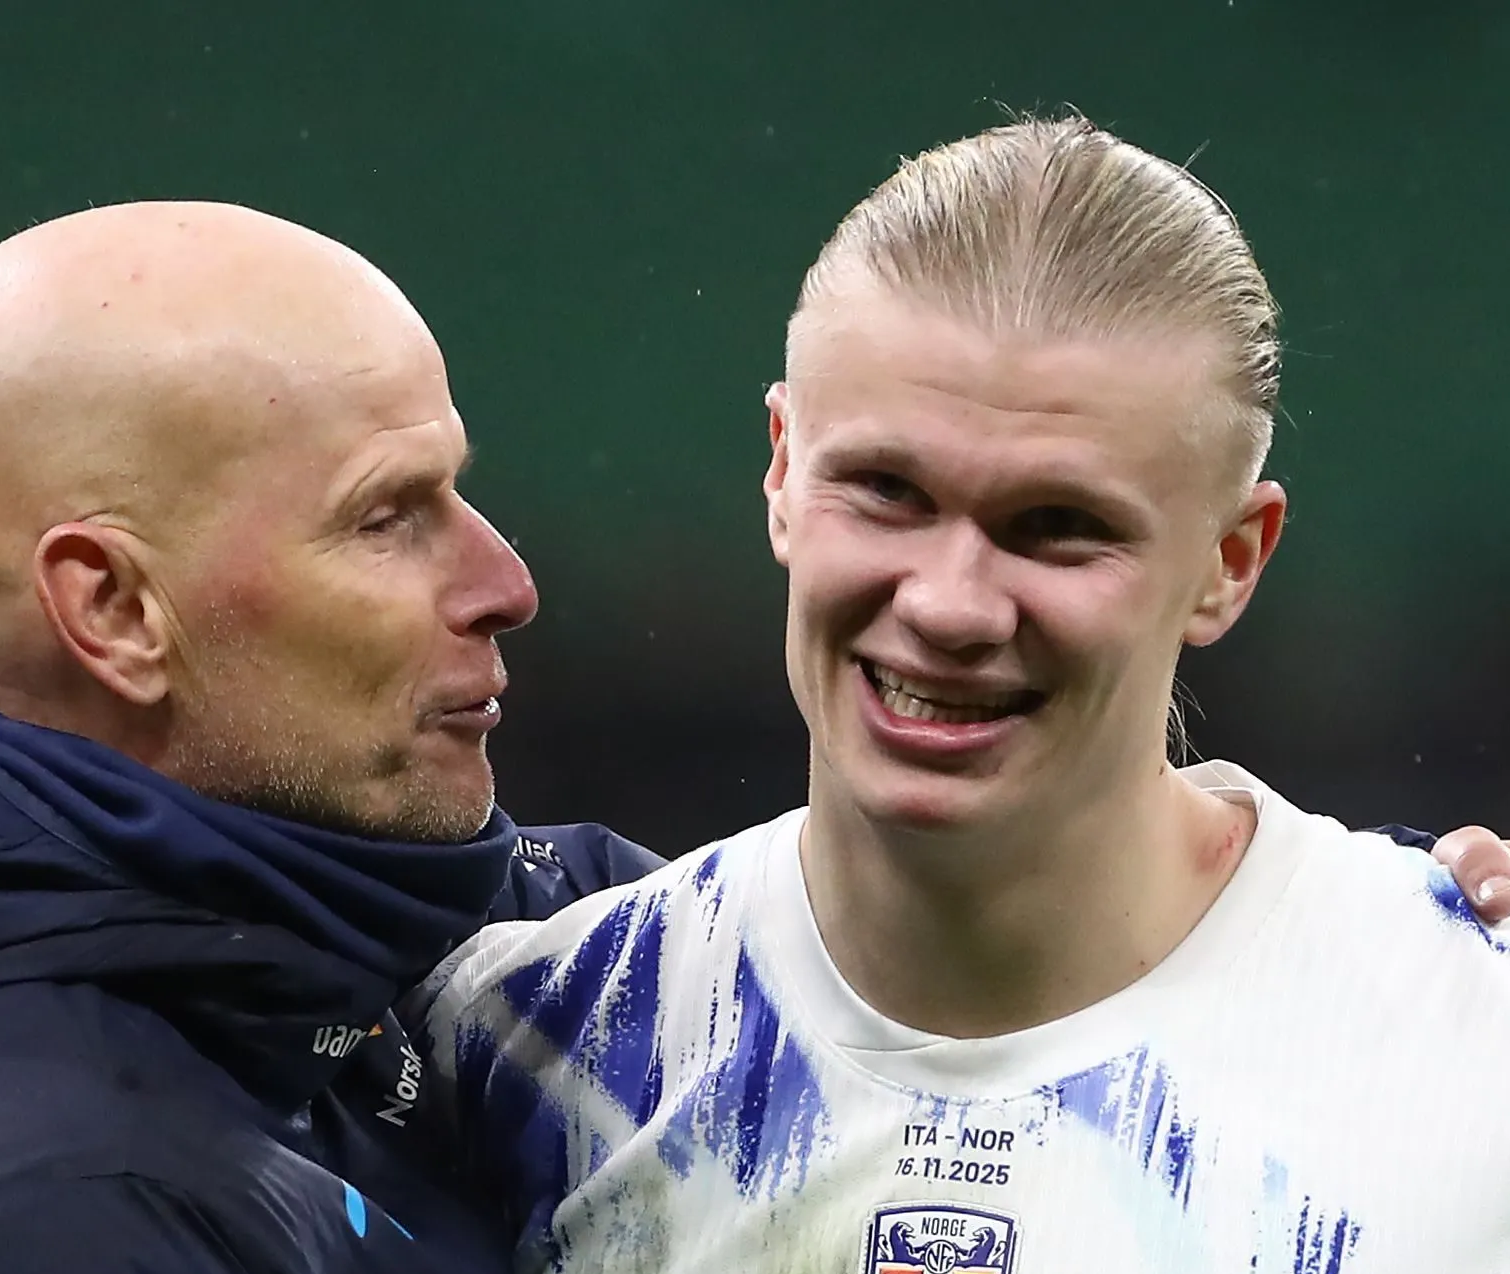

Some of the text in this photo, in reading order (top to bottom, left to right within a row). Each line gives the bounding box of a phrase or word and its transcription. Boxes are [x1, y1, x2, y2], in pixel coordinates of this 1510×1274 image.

[904, 1124, 937, 1146] ITA
[961, 1127, 1015, 1152] NOR
[895, 1157, 1011, 1185] 16.11.2025
[920, 1217, 968, 1237] NORGE
